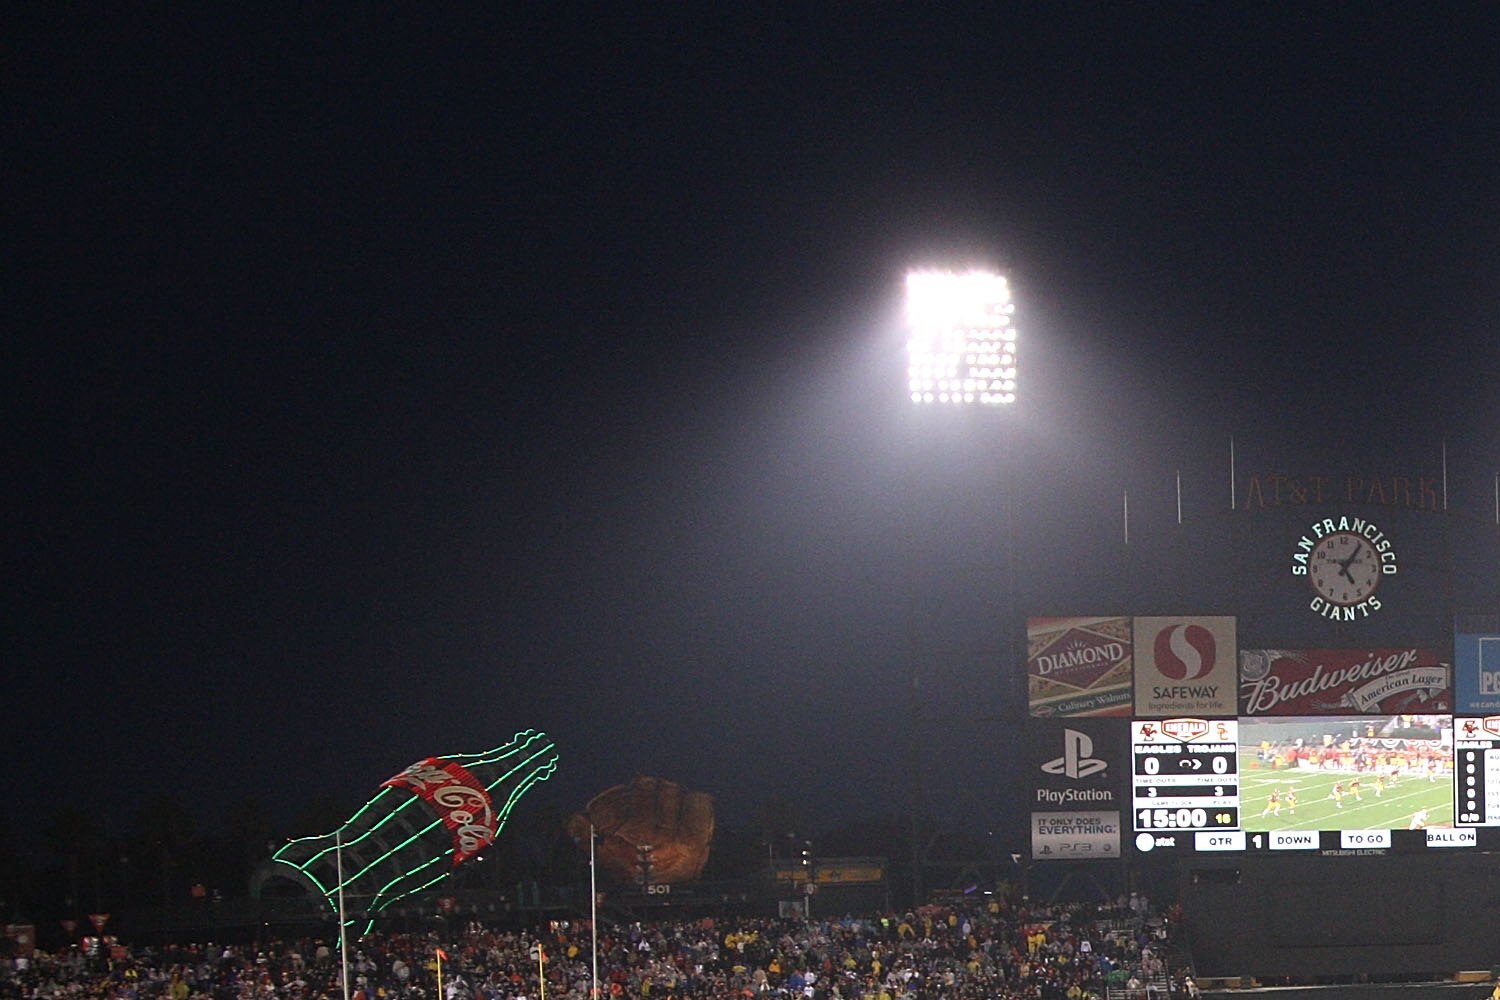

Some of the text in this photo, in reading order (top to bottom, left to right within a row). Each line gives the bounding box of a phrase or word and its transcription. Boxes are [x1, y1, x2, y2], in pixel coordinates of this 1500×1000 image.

[1246, 475, 1438, 512] AT&T PARK
[1292, 516, 1397, 576] SAN FRANCISCO
[1310, 596, 1381, 621] GIANTS
[1037, 642, 1123, 675] DIAMOND
[1242, 649, 1417, 714] Budweiser
[1360, 676, 1409, 704] American
[1412, 671, 1443, 685] Lager
[1153, 686, 1218, 699] SAFEWAY
[1134, 744, 1182, 754] EAGLES
[1144, 757, 1160, 774] 0
[1212, 756, 1228, 774] 0
[1037, 788, 1112, 805] PlayStation
[1038, 817, 1100, 826] IT ONLY DOES
[1138, 808, 1207, 828] 15:00
[1209, 835, 1262, 849] QTR 1
[1277, 835, 1312, 845] DOWN
[1348, 835, 1384, 844] TO GO
[1427, 833, 1475, 842] BALL ON
[648, 884, 671, 894] 501
